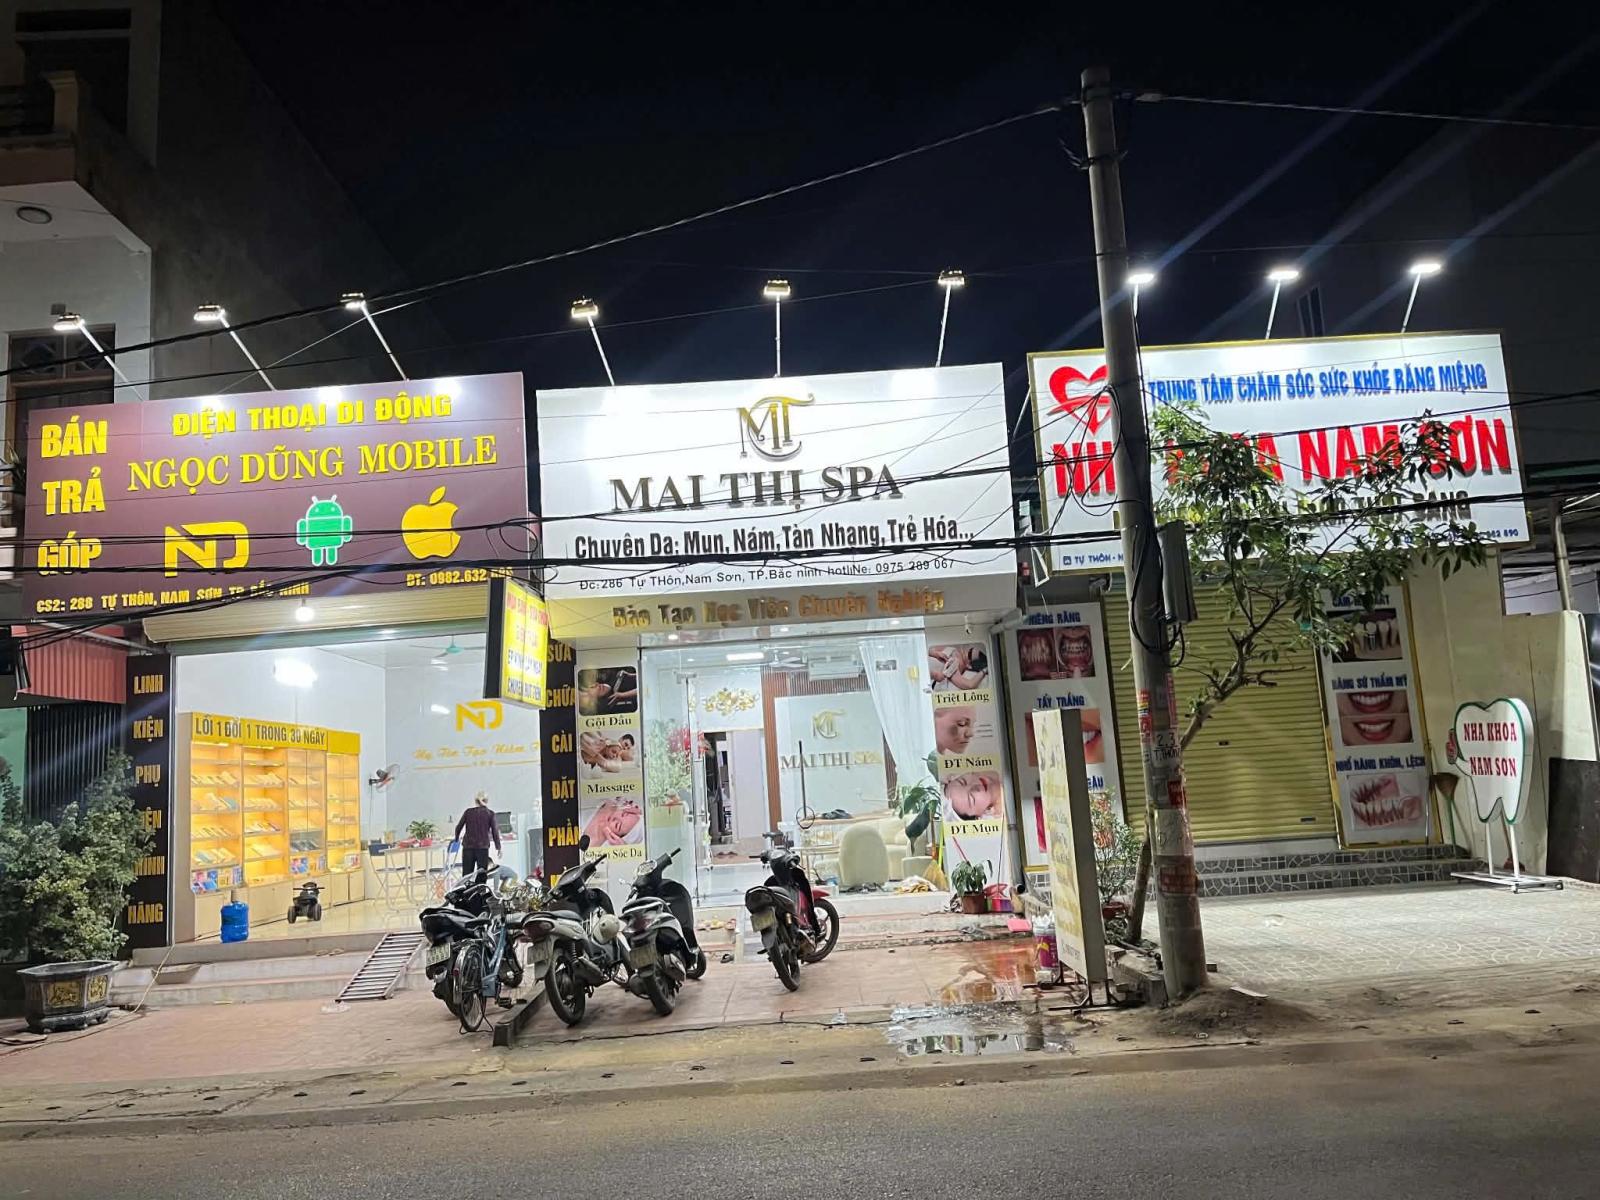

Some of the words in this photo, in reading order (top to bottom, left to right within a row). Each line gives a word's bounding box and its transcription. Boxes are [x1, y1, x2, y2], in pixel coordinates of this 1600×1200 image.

[1148, 378, 1197, 402] TRUNG
[1201, 372, 1233, 403] TÂM
[1237, 370, 1281, 402] CHĂM
[1286, 368, 1314, 399] SÓC
[171, 407, 236, 439] ĐIỆN
[247, 402, 327, 433] THOẠI
[336, 400, 364, 425] DI
[375, 391, 453, 424] ĐỘNG
[41, 414, 108, 458] BÁN
[127, 454, 230, 495] NGỌC
[239, 444, 345, 483] DŨNG
[358, 435, 498, 475] MOBILE
[1050, 440, 1118, 498] NH
[42, 467, 106, 516] TRẢ
[610, 474, 705, 514] MAI
[820, 463, 904, 502] SPA
[37, 530, 103, 576] GÓP
[650, 532, 680, 556] Da:
[160, 590, 190, 605] NAM
[133, 674, 164, 695] LINH
[133, 715, 164, 742] KIỆN
[217, 721, 222, 737] 1
[255, 724, 287, 741] TRONG
[290, 729, 301, 744] 30
[551, 730, 573, 753] CÀI
[1463, 723, 1485, 742] NHA
[1487, 722, 1517, 742] KHOA
[135, 764, 161, 788] PHỤ
[1470, 757, 1492, 776] NAM
[551, 777, 576, 804] ĐẶT
[587, 783, 635, 794] Massage
